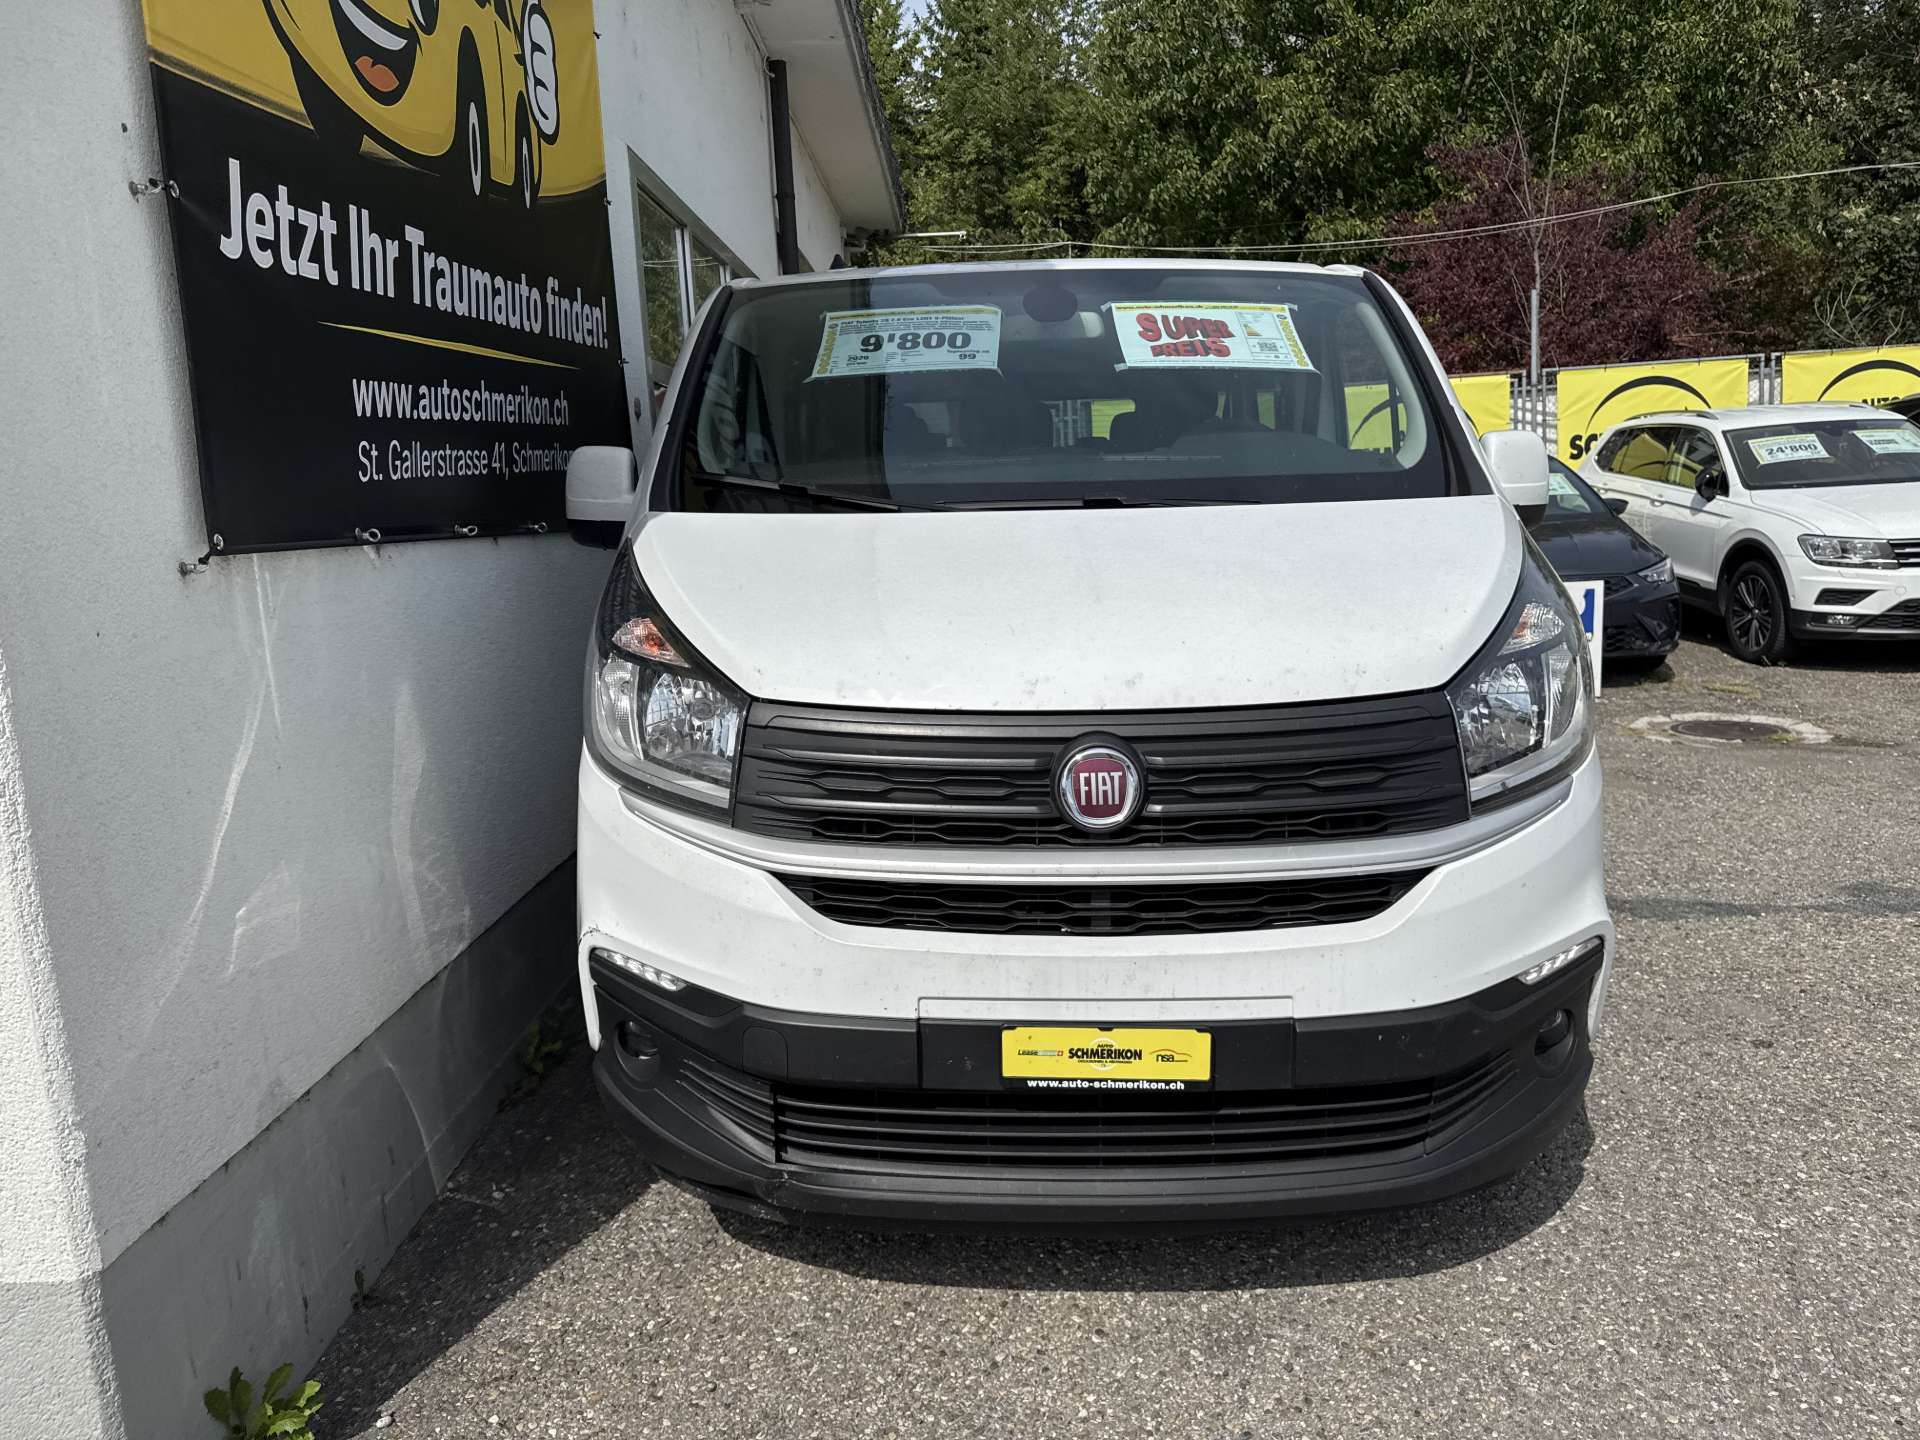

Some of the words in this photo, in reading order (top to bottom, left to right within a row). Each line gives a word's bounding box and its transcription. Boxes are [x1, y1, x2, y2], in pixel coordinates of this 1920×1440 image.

[220, 157, 339, 287] Jetzt
[348, 203, 399, 299] Ihr
[405, 224, 542, 336] Traumauto
[545, 276, 609, 349] finden!
[1136, 313, 1236, 342] SUPER
[860, 331, 972, 353] 9'800
[1150, 338, 1231, 358] PREIS
[353, 378, 569, 427] www.autoschmerikon.ch
[358, 440, 383, 483] St.
[388, 439, 488, 480] Gallerstrasse
[491, 441, 509, 481] 41,
[1765, 443, 1818, 456] 24'800
[1079, 771, 1123, 806] FIAT
[1068, 1047, 1143, 1061] SCHMERIKON
[1027, 1079, 1185, 1090] www.auto-schmerikon.ch
